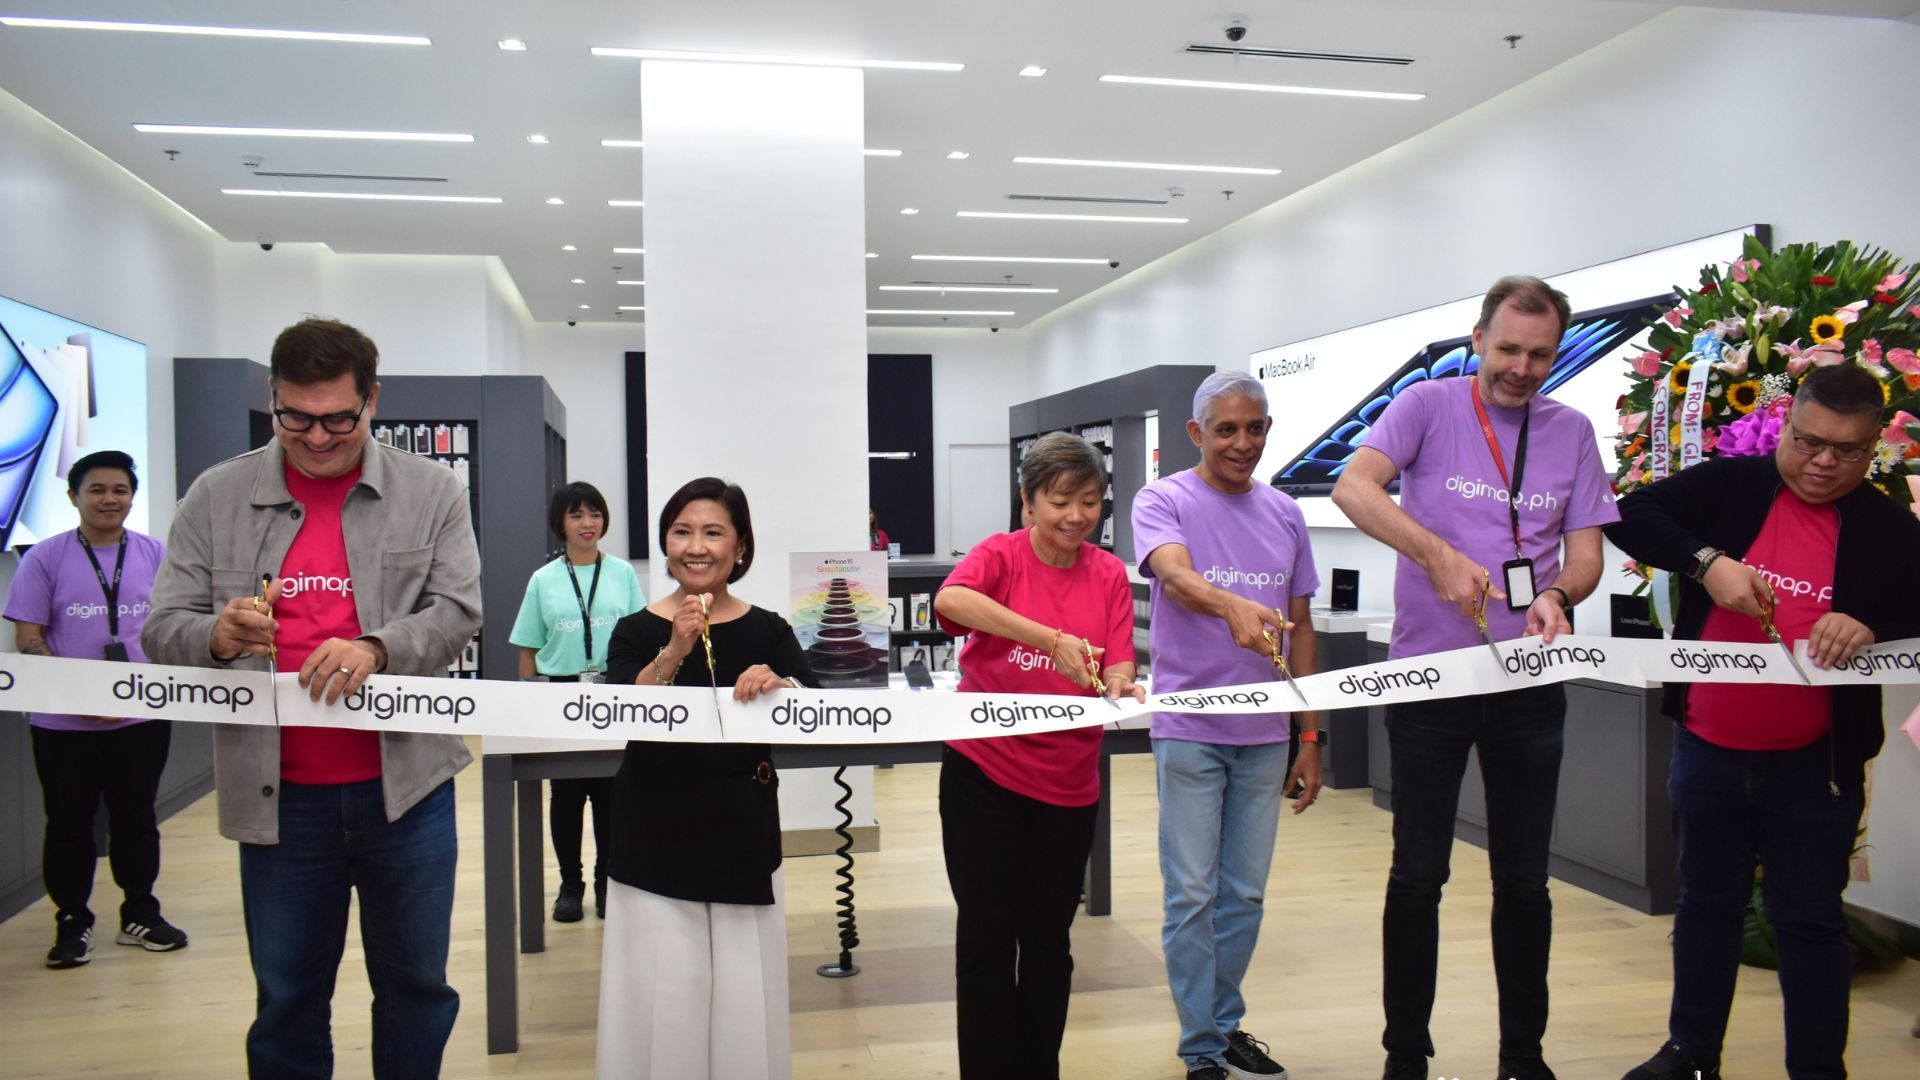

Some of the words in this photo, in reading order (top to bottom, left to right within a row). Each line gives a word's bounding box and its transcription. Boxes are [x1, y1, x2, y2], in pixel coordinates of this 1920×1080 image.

[1265, 357, 1302, 379] MacBook
[1304, 354, 1316, 372] Air
[1683, 381, 1703, 433] FROM:
[66, 601, 151, 619] digimp.ph
[113, 674, 255, 713] digimap
[344, 684, 476, 724] digimap
[563, 694, 689, 732] digimap
[771, 698, 892, 734] digimap
[970, 701, 1085, 728] digimap
[1159, 691, 1270, 710] digimap
[1339, 668, 1441, 697] digimap
[1505, 642, 1606, 677] digimap
[1670, 647, 1767, 675] digimap
